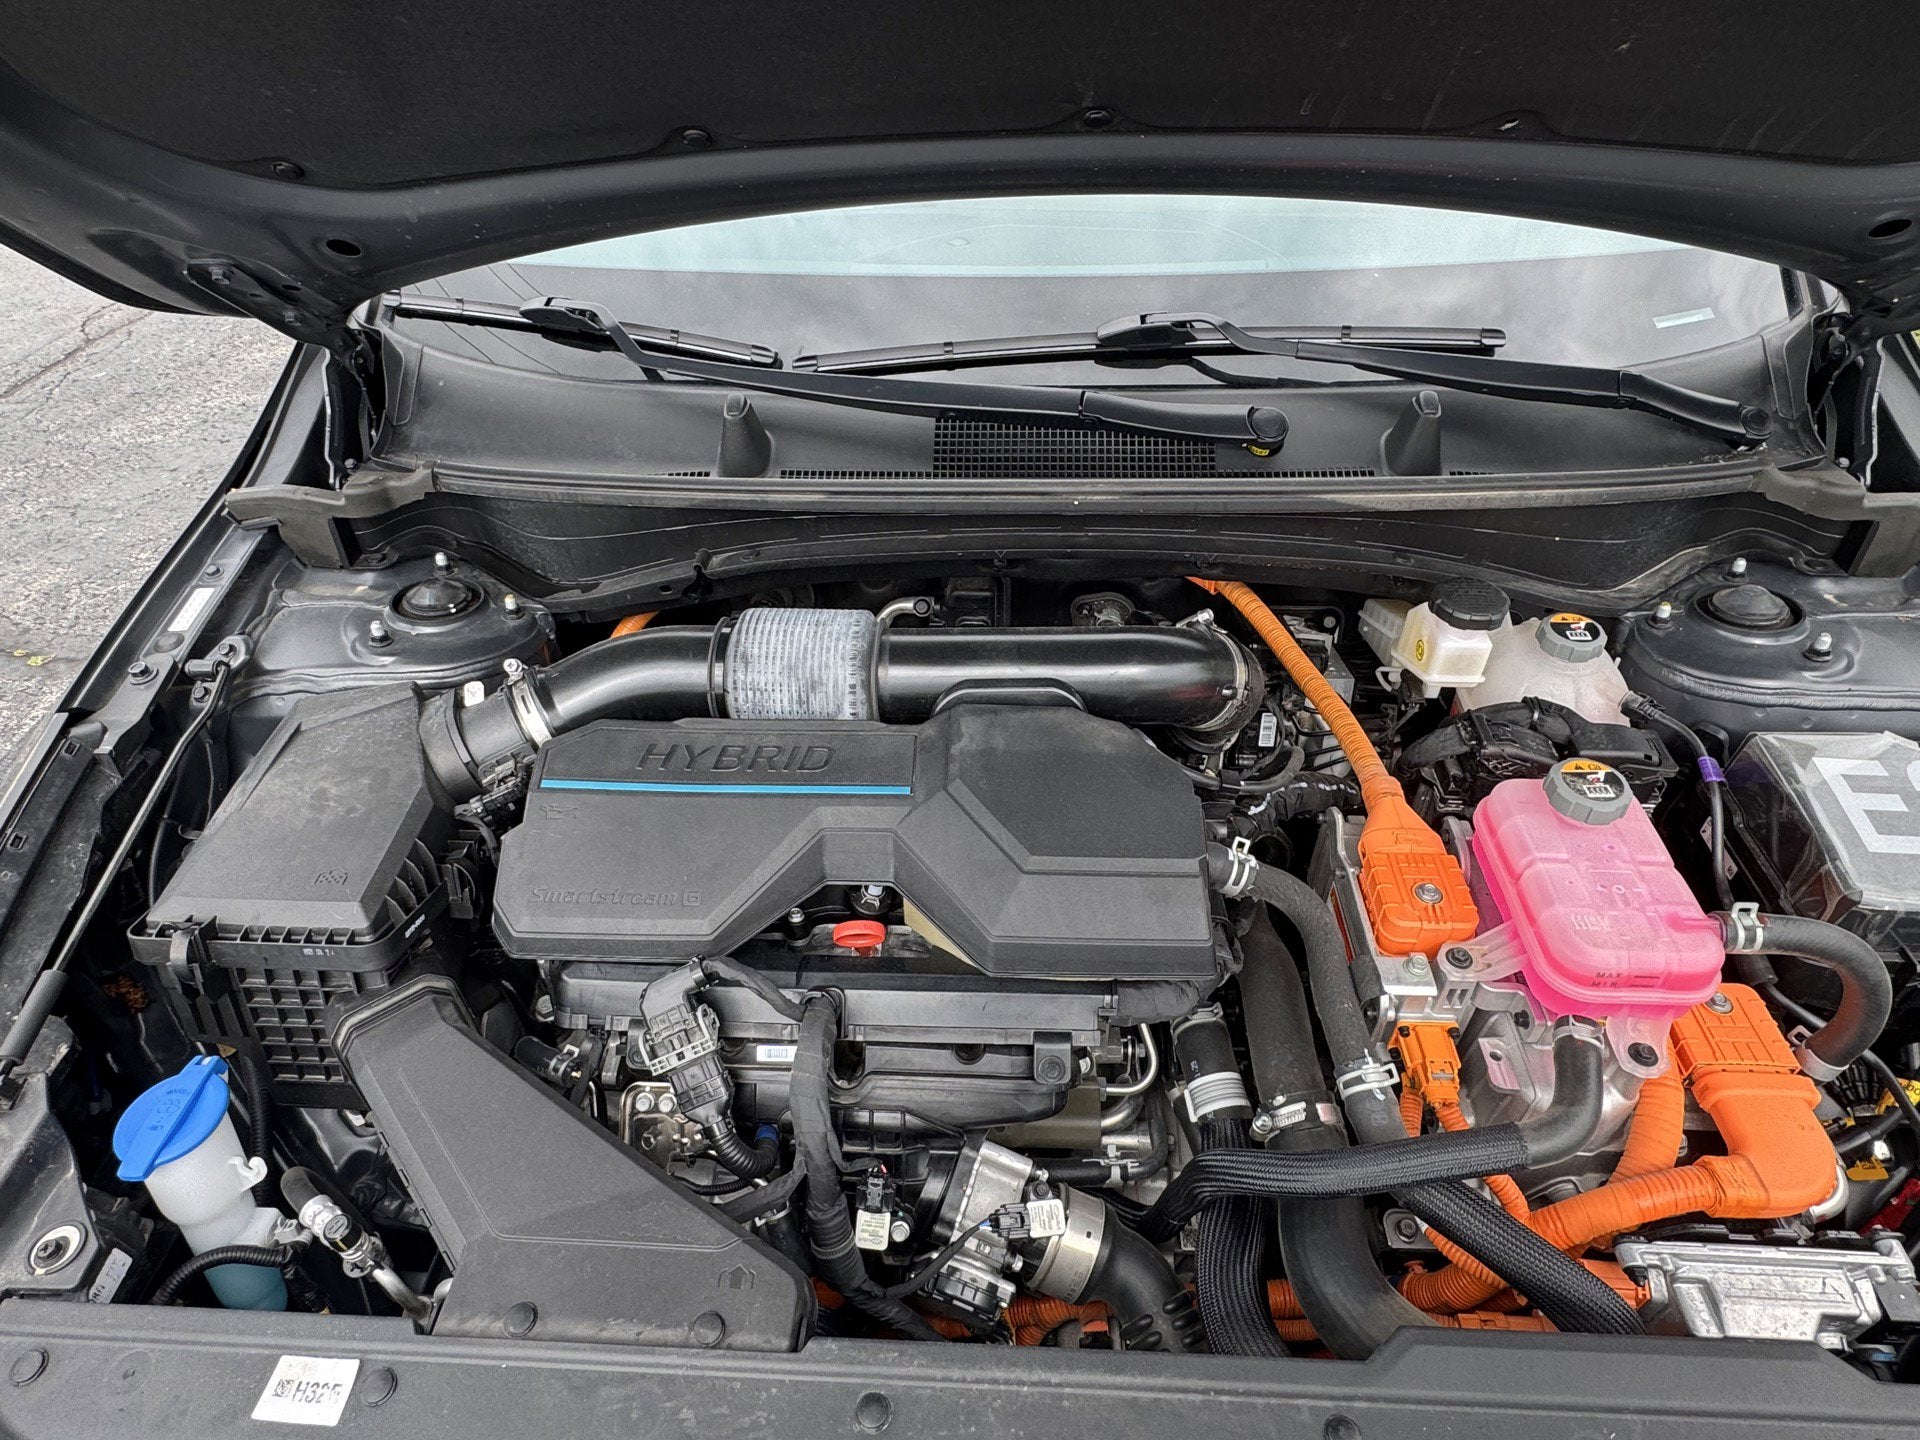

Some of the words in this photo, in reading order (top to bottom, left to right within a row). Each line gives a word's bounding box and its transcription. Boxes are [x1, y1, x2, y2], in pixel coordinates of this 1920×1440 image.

[635, 742, 837, 773] HYBRID
[1811, 756, 1920, 854] E
[529, 887, 678, 906] Smartstream
[1590, 980, 1617, 988] MIN
[1595, 971, 1621, 979] MAX
